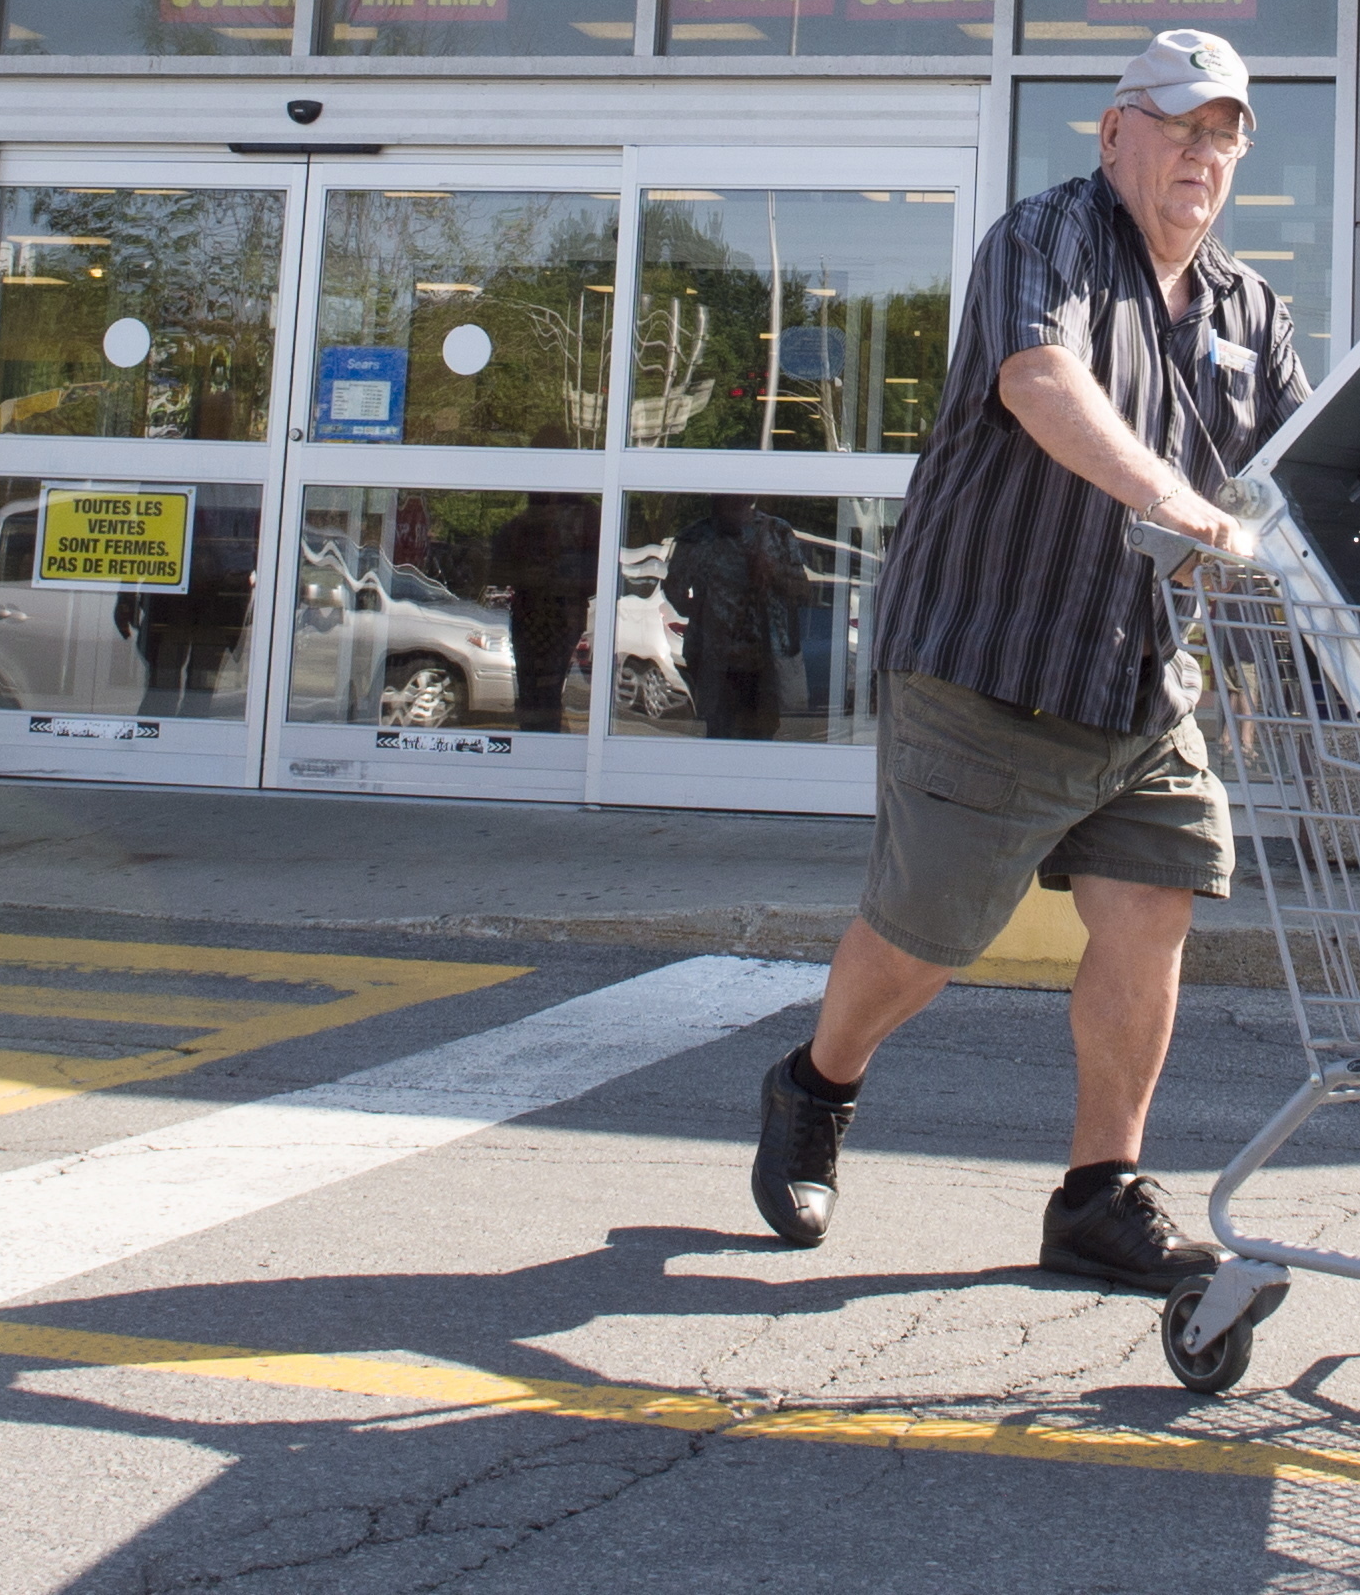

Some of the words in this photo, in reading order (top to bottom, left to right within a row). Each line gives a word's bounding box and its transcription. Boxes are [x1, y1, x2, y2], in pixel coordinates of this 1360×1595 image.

[347, 358, 380, 370] Sears
[74, 498, 131, 516] TOUTES
[136, 501, 162, 517] LES
[88, 519, 146, 535] VENTES
[58, 537, 100, 553] SONT
[47, 556, 77, 572] PAS
[83, 558, 103, 573] DE
[108, 559, 177, 576] RETOURS
